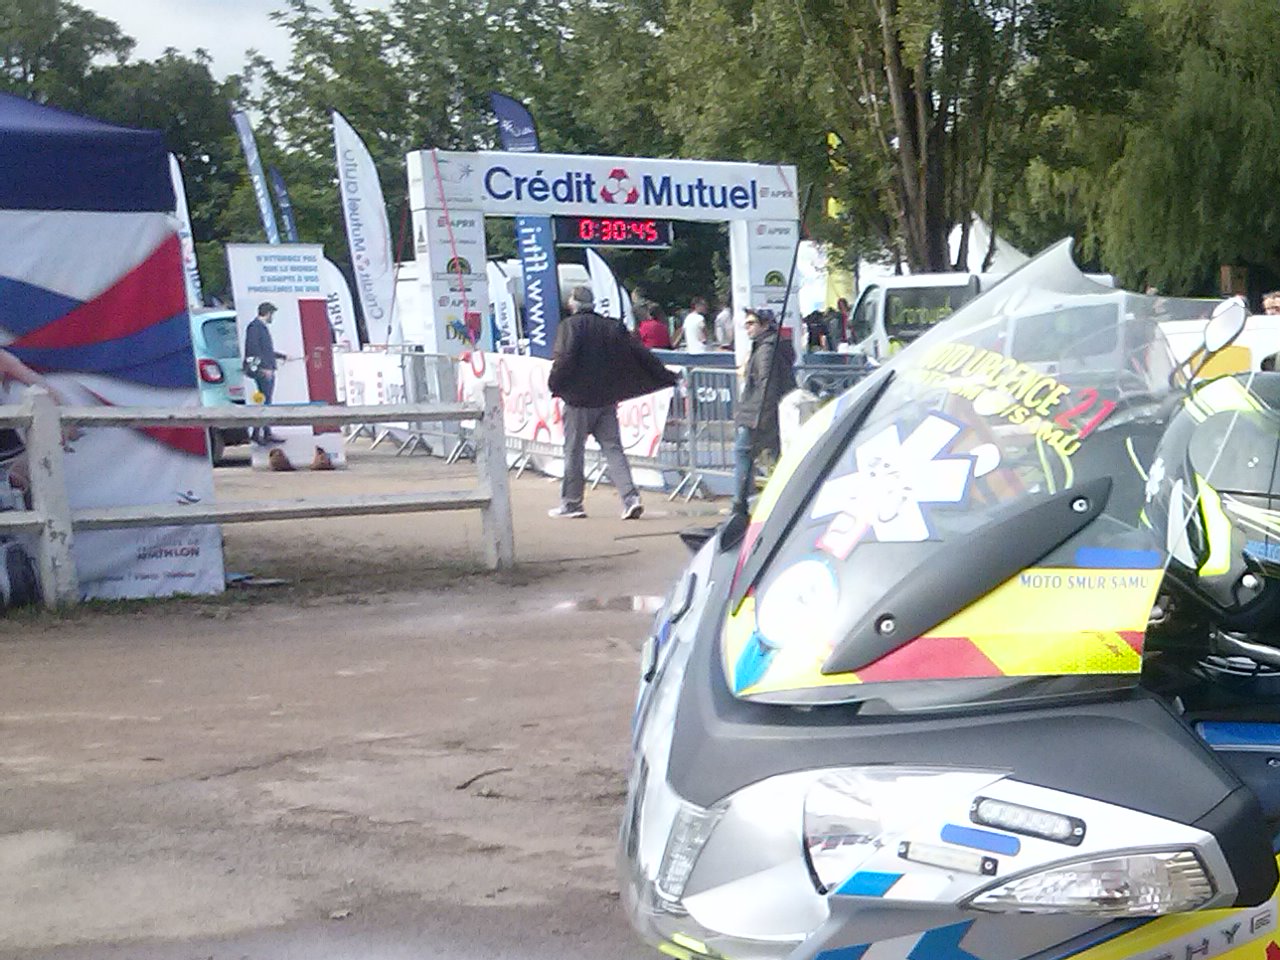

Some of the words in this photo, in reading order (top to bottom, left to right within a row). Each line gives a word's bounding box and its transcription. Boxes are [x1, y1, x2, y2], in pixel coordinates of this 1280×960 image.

[484, 167, 597, 204] Crédit
[643, 175, 757, 210] Mutuel
[579, 218, 658, 242] 0:30:45
[450, 298, 477, 307] APR
[1055, 387, 1117, 440] 21
[1020, 574, 1062, 589] MOTO
